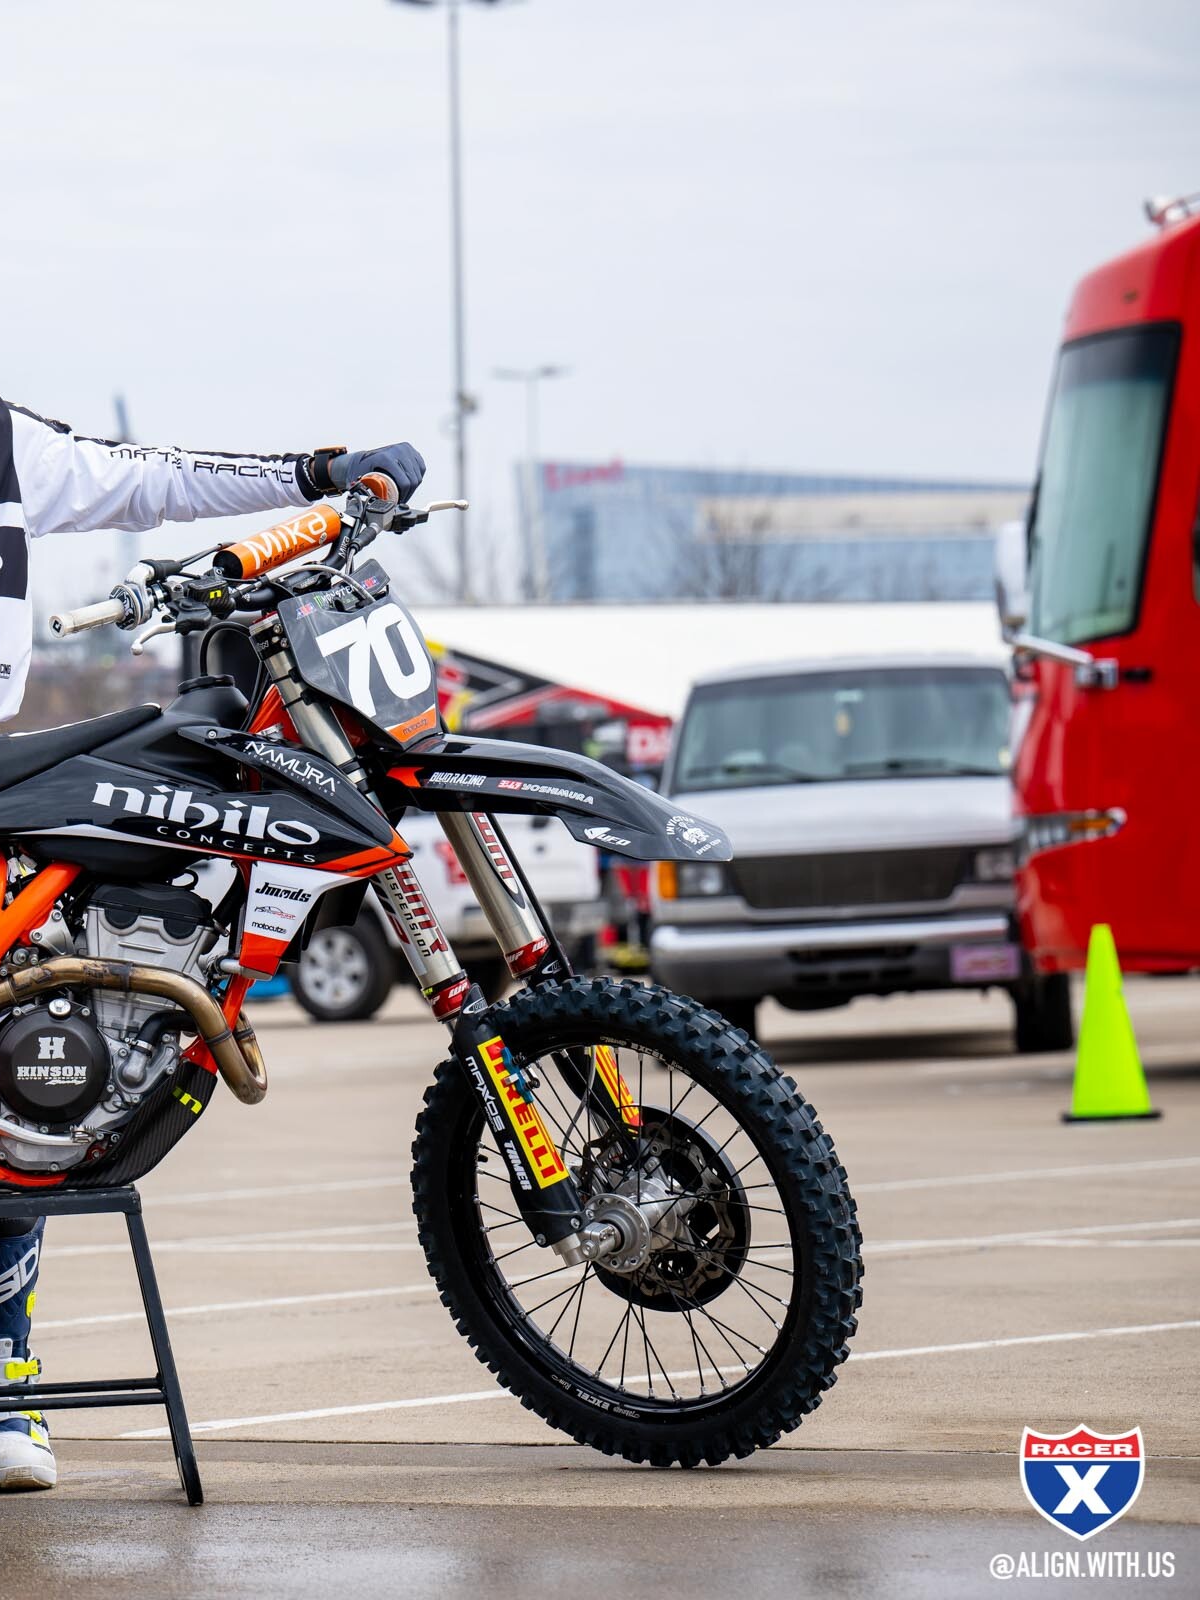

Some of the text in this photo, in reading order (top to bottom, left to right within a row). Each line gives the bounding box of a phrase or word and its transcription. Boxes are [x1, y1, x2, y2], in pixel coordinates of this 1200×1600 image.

[315, 602, 432, 718] 70
[245, 741, 336, 793] NAMURA
[92, 782, 320, 846] nihilo
[521, 783, 594, 805] YOSHIMURA
[156, 825, 316, 863] CONCEPTS
[385, 872, 431, 957] USPENSION
[17, 1066, 87, 1077] HINSON
[576, 1388, 611, 1411] EXCEL
